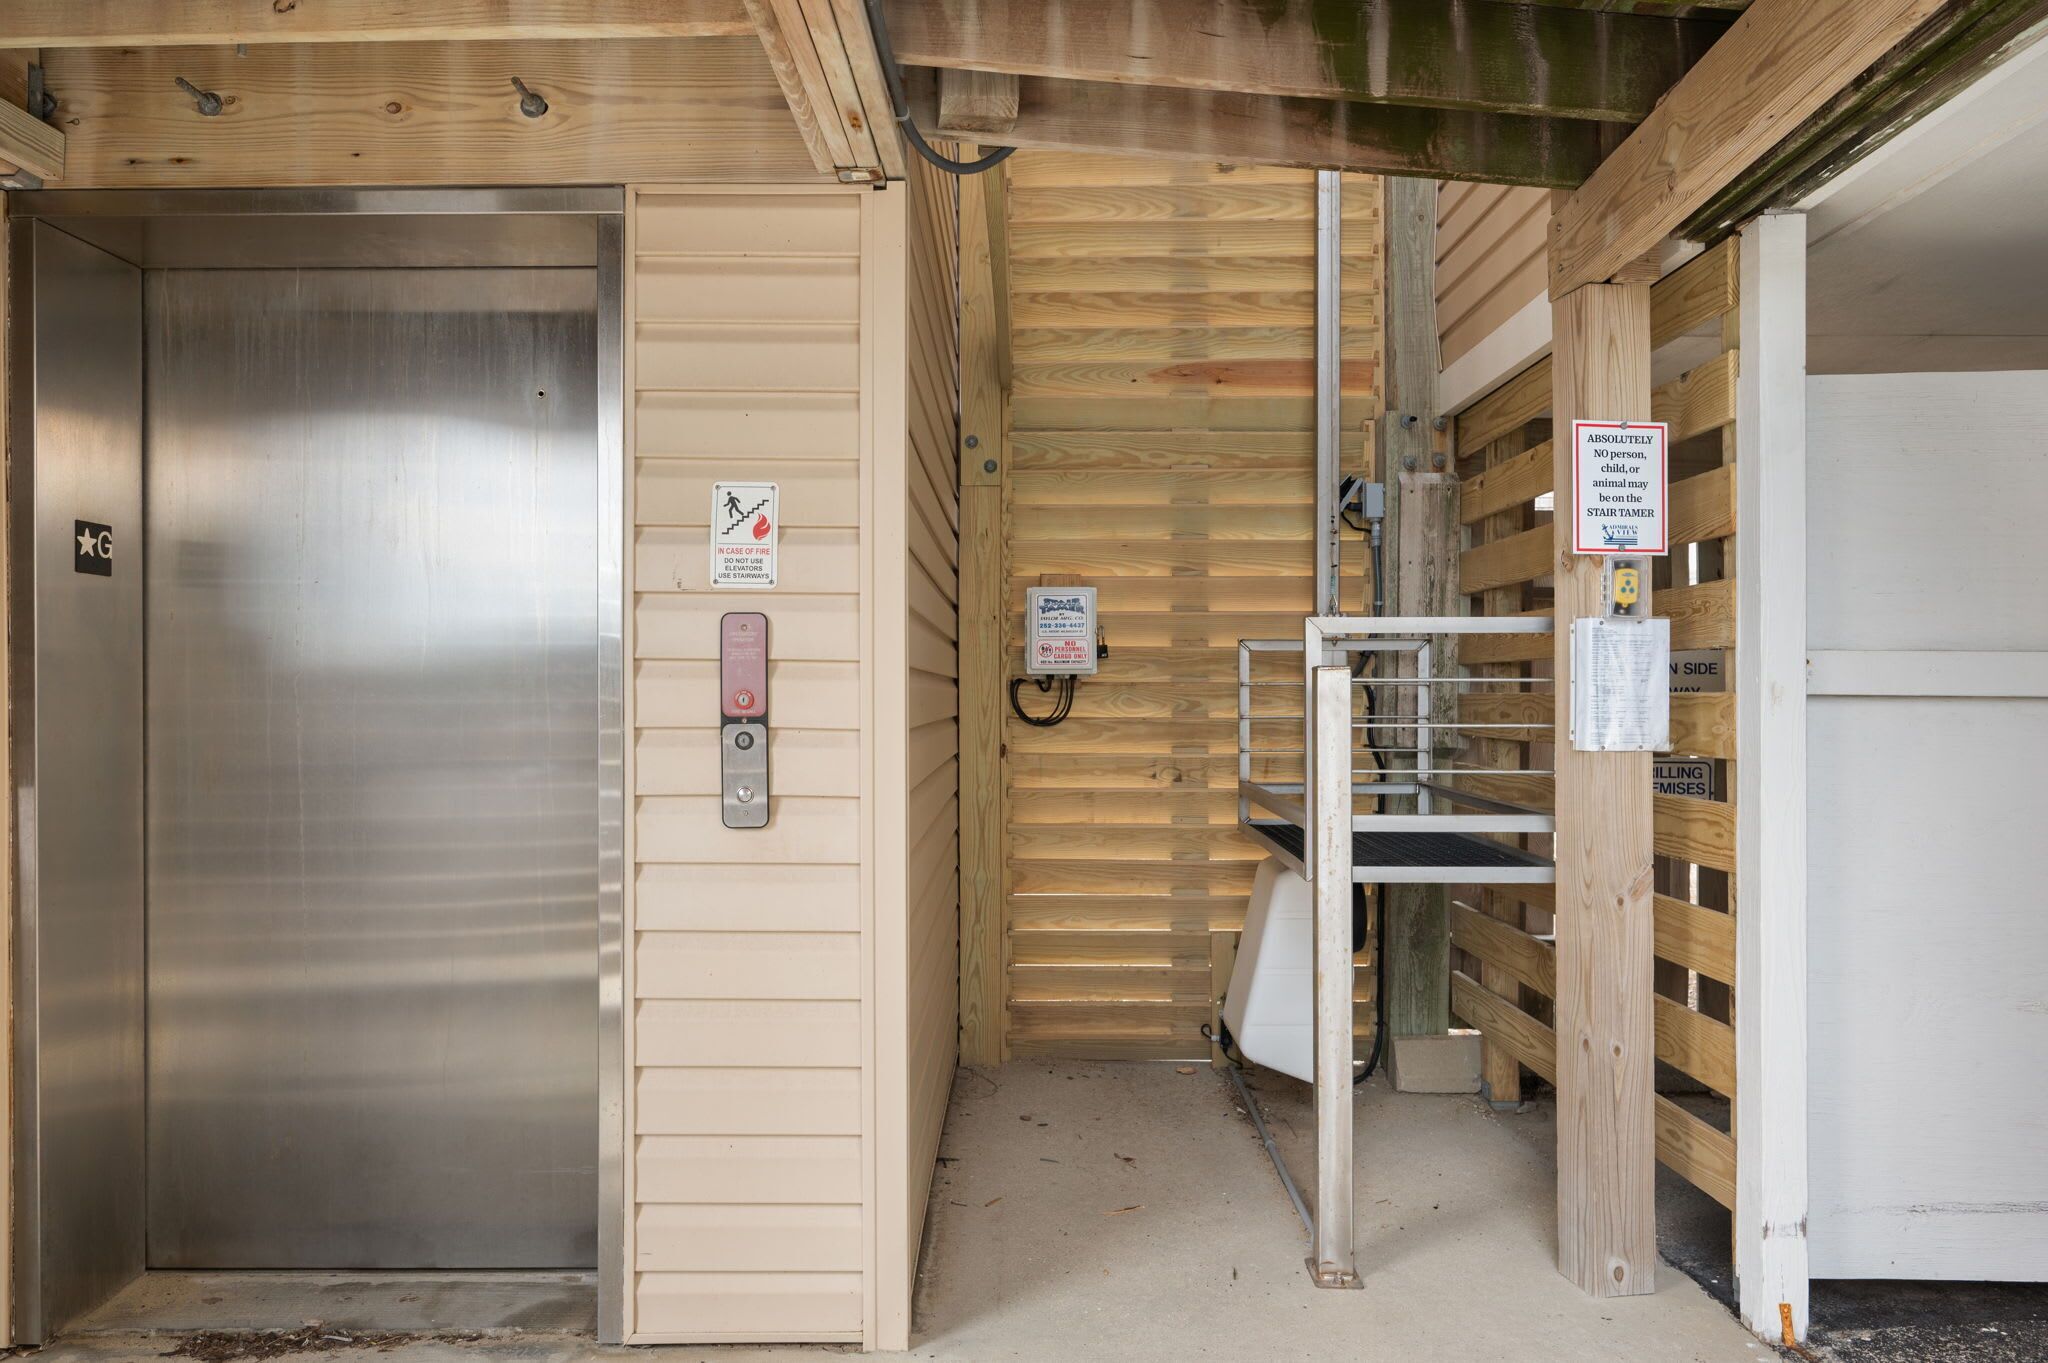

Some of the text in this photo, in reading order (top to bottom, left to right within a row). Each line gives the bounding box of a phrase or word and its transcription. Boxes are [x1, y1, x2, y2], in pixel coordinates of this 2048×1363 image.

[1587, 434, 1653, 444] ABSOLUTELY
[1594, 449, 1647, 460] NO person,
[1601, 464, 1628, 474] child,
[1593, 478, 1648, 490] animal may
[1599, 493, 1611, 502] be
[1626, 493, 1642, 503] the
[1587, 508, 1655, 518] STAIR TAMER
[98, 531, 112, 559] G
[1683, 662, 1718, 675] SIDE
[1653, 766, 1703, 779] ILLING
